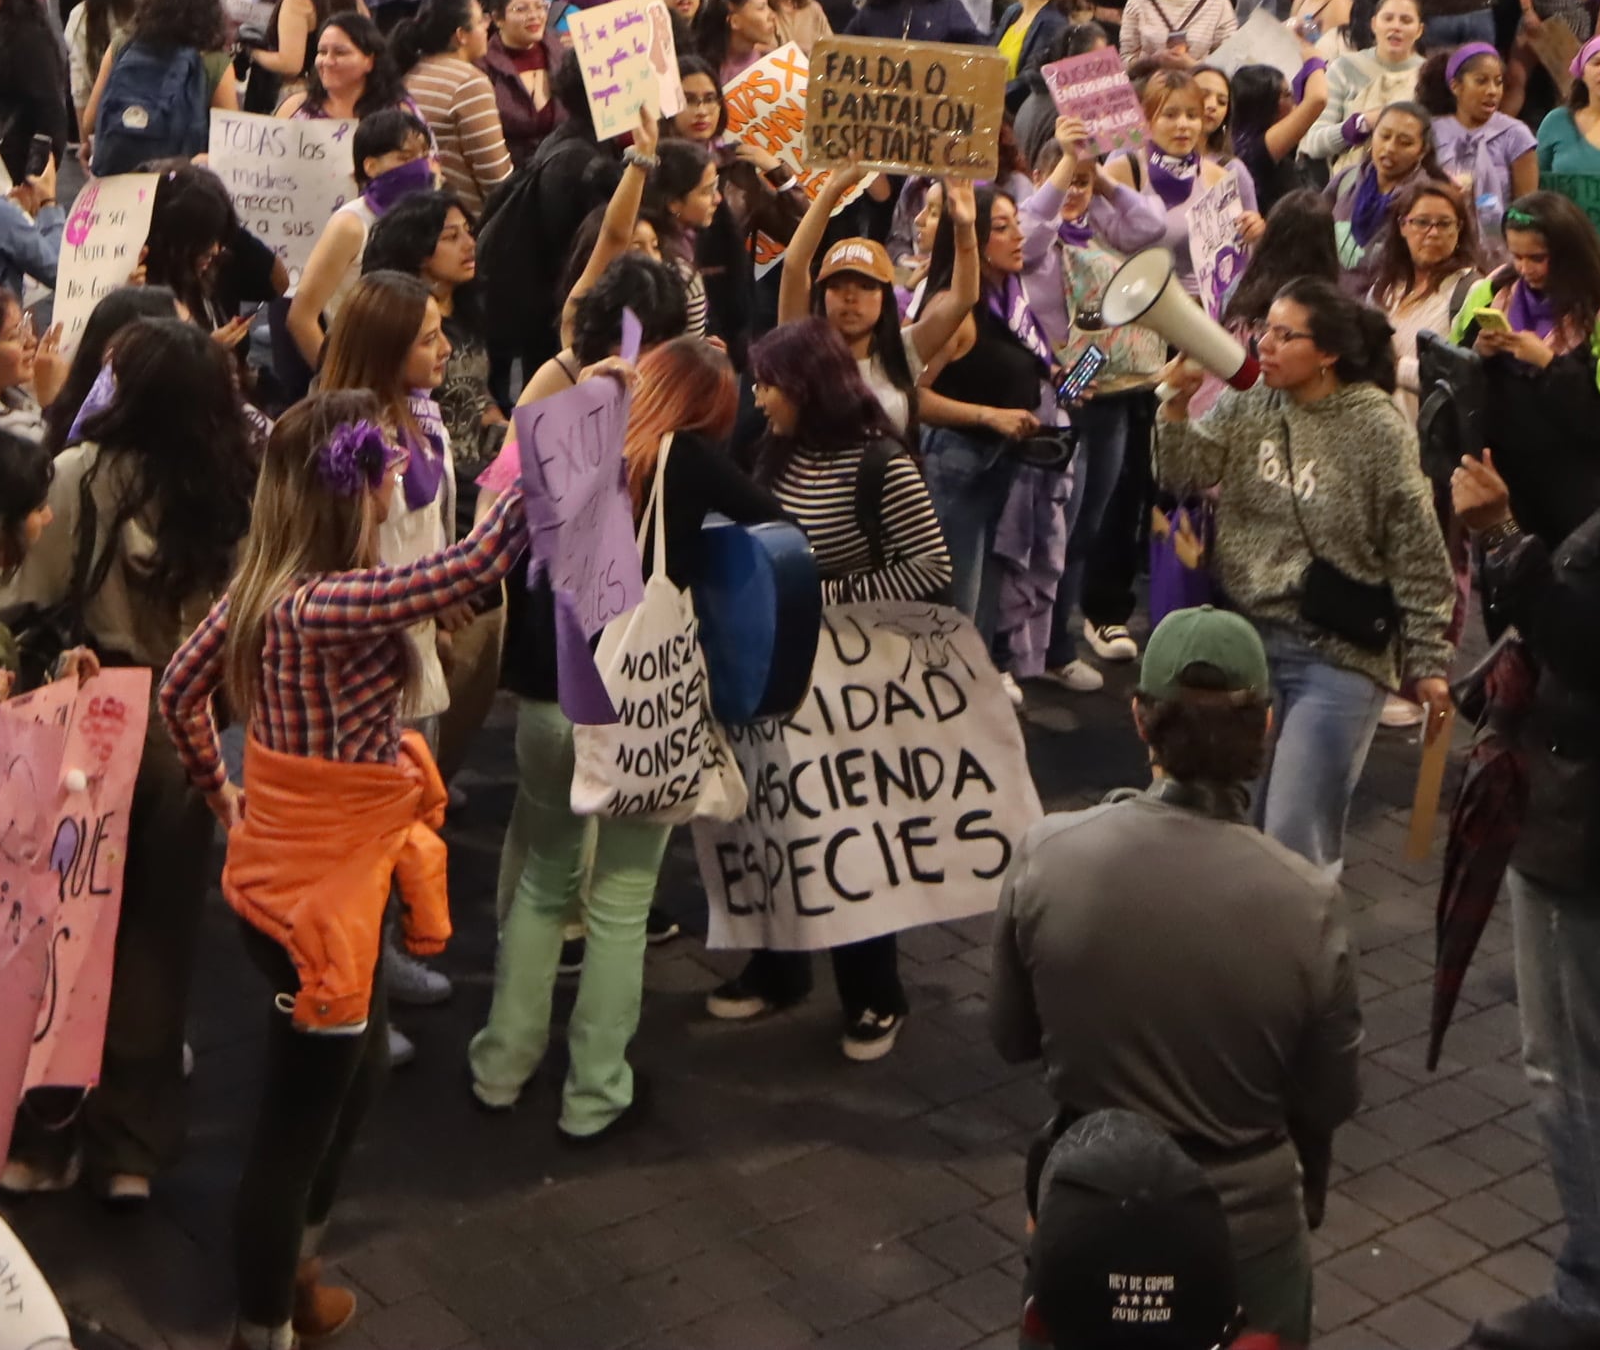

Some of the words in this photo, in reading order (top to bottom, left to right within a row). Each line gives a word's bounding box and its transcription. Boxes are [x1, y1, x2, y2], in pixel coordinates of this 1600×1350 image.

[825, 52, 913, 91] FALDA
[924, 61, 947, 96] O
[220, 119, 287, 158] TODAS
[298, 132, 326, 161] las
[812, 124, 937, 166] RESPETAME
[232, 164, 298, 192] madres
[282, 220, 315, 236] sus
[716, 809, 1013, 916] ESPECIES
[1109, 1273, 1127, 1290] REY
[1130, 1275, 1142, 1291] DE
[1145, 1276, 1175, 1291] COPAS
[1112, 1306, 1171, 1323] 2010-2020
